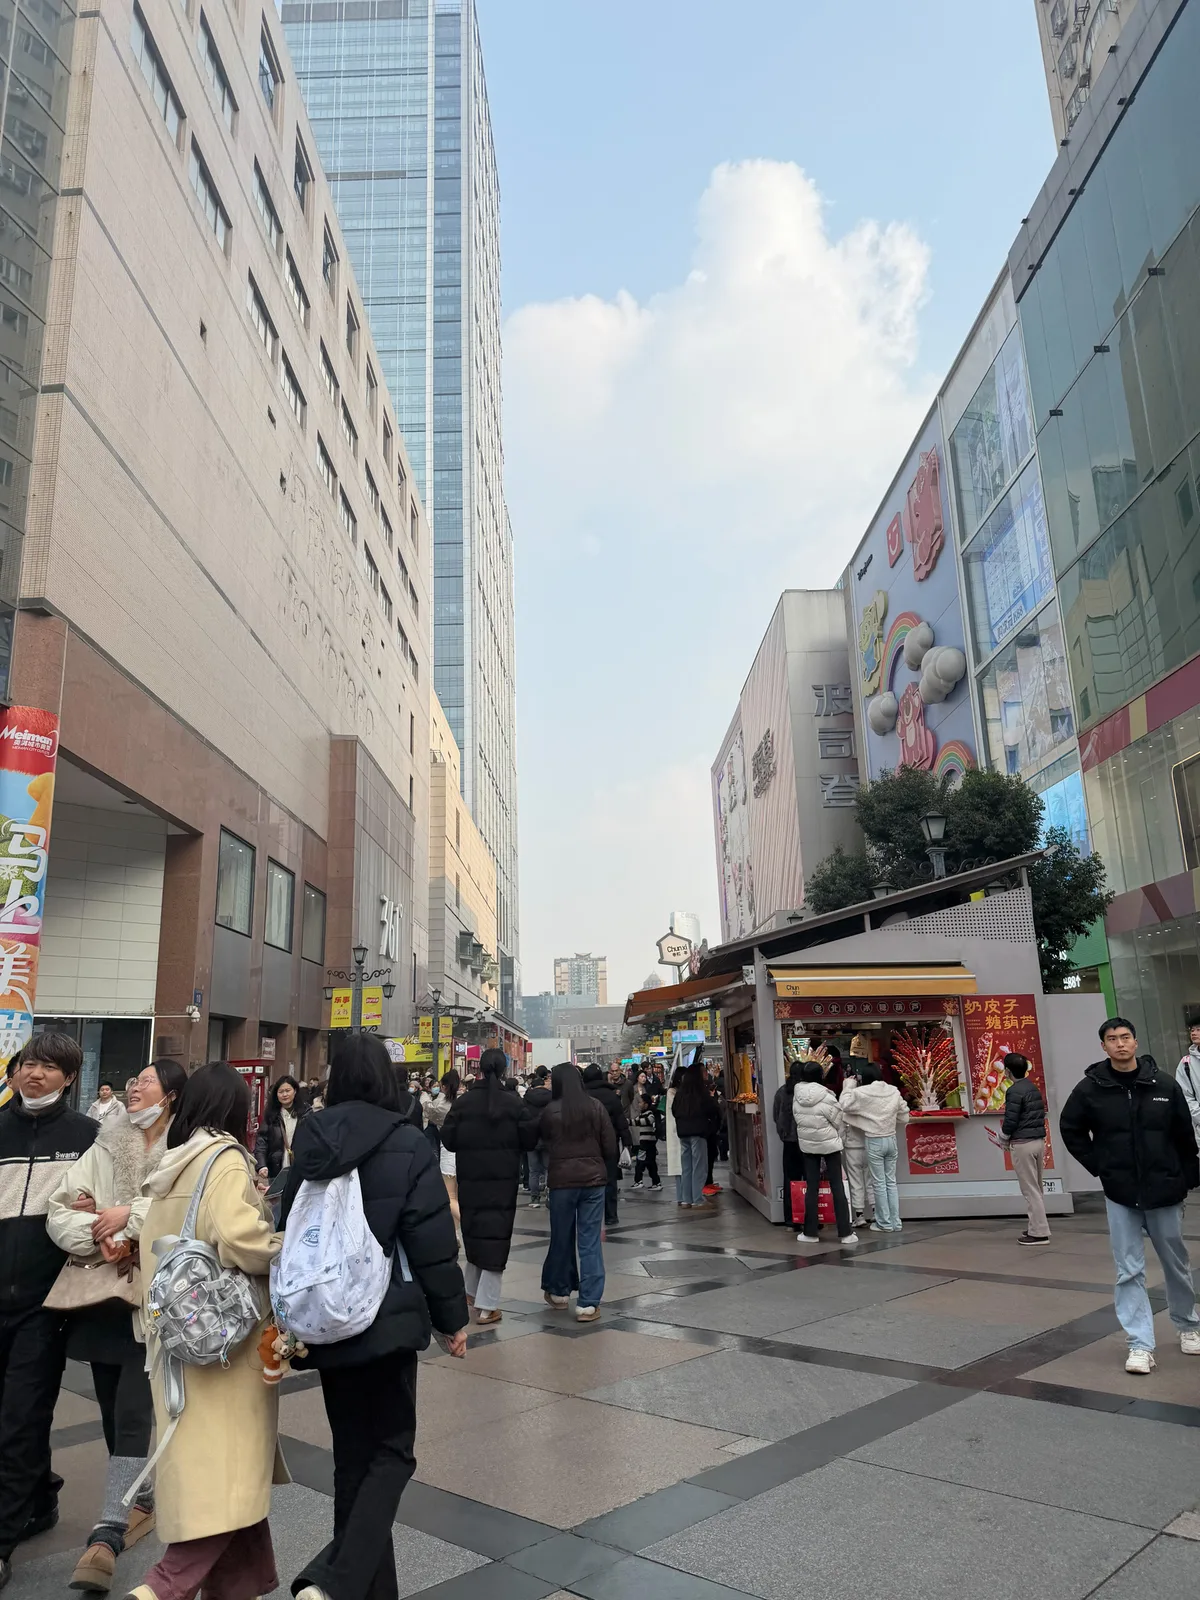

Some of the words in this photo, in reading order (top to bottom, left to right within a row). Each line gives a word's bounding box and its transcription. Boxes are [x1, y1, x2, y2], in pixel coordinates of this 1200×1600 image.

[0, 725, 53, 746] Meiman
[813, 1000, 921, 1015] 老北京冰糖葫芦
[965, 999, 1019, 1015] 奶皮子
[985, 1015, 1035, 1030] 糖葫芦
[55, 1151, 80, 1160] Swanky
